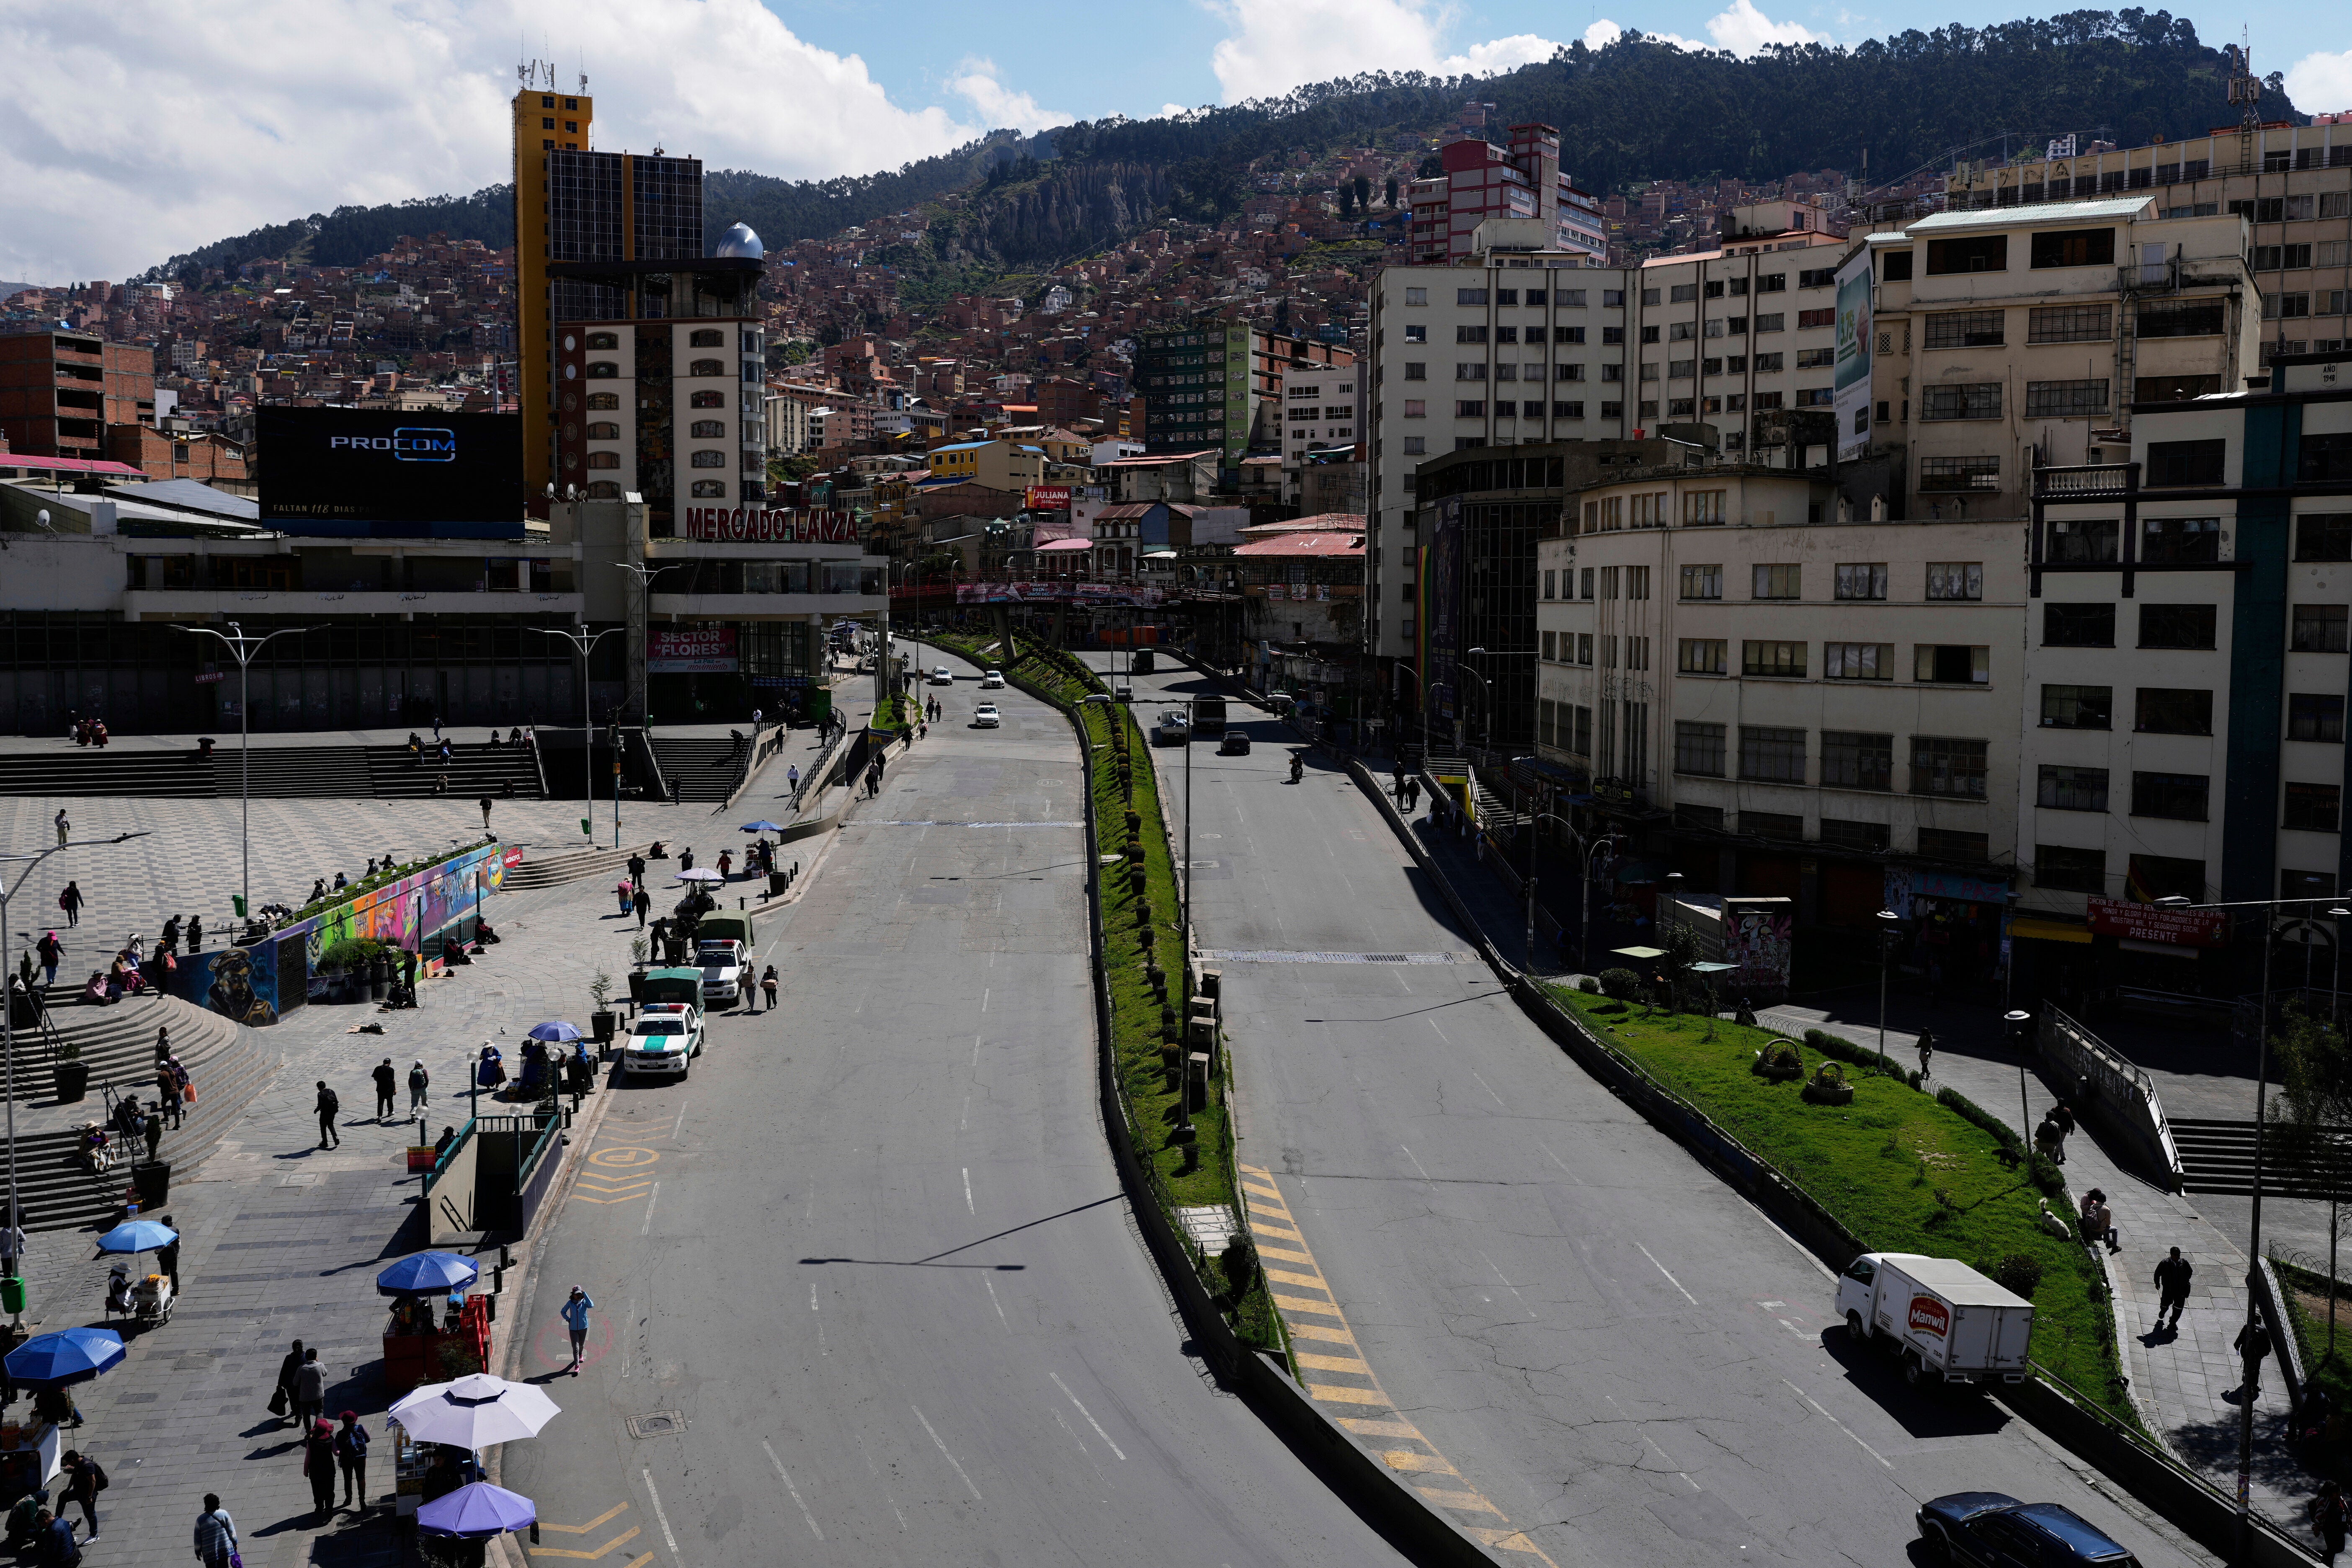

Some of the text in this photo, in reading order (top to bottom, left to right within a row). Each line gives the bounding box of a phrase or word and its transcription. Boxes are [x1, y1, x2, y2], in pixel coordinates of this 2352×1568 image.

[331, 436, 455, 451] PROCOM
[312, 504, 329, 513] 118
[686, 508, 858, 541] MERCADO LANZA
[660, 630, 720, 642] SECTOR
[1602, 785, 1622, 799] EROS
[505, 854, 521, 864] MONOPOL
[1922, 877, 2001, 901] LA PAZ
[2116, 901, 2141, 910] JUBILADOS
[2160, 914, 2191, 924] FORJADORES
[2154, 922, 2180, 931] SEGURIDAD
[2130, 927, 2177, 942] PRESENTE
[1917, 1304, 1942, 1315] EMBUTIDOS
[1911, 1309, 1945, 1331] Manwil
[1932, 1333, 1943, 1342] distingue
